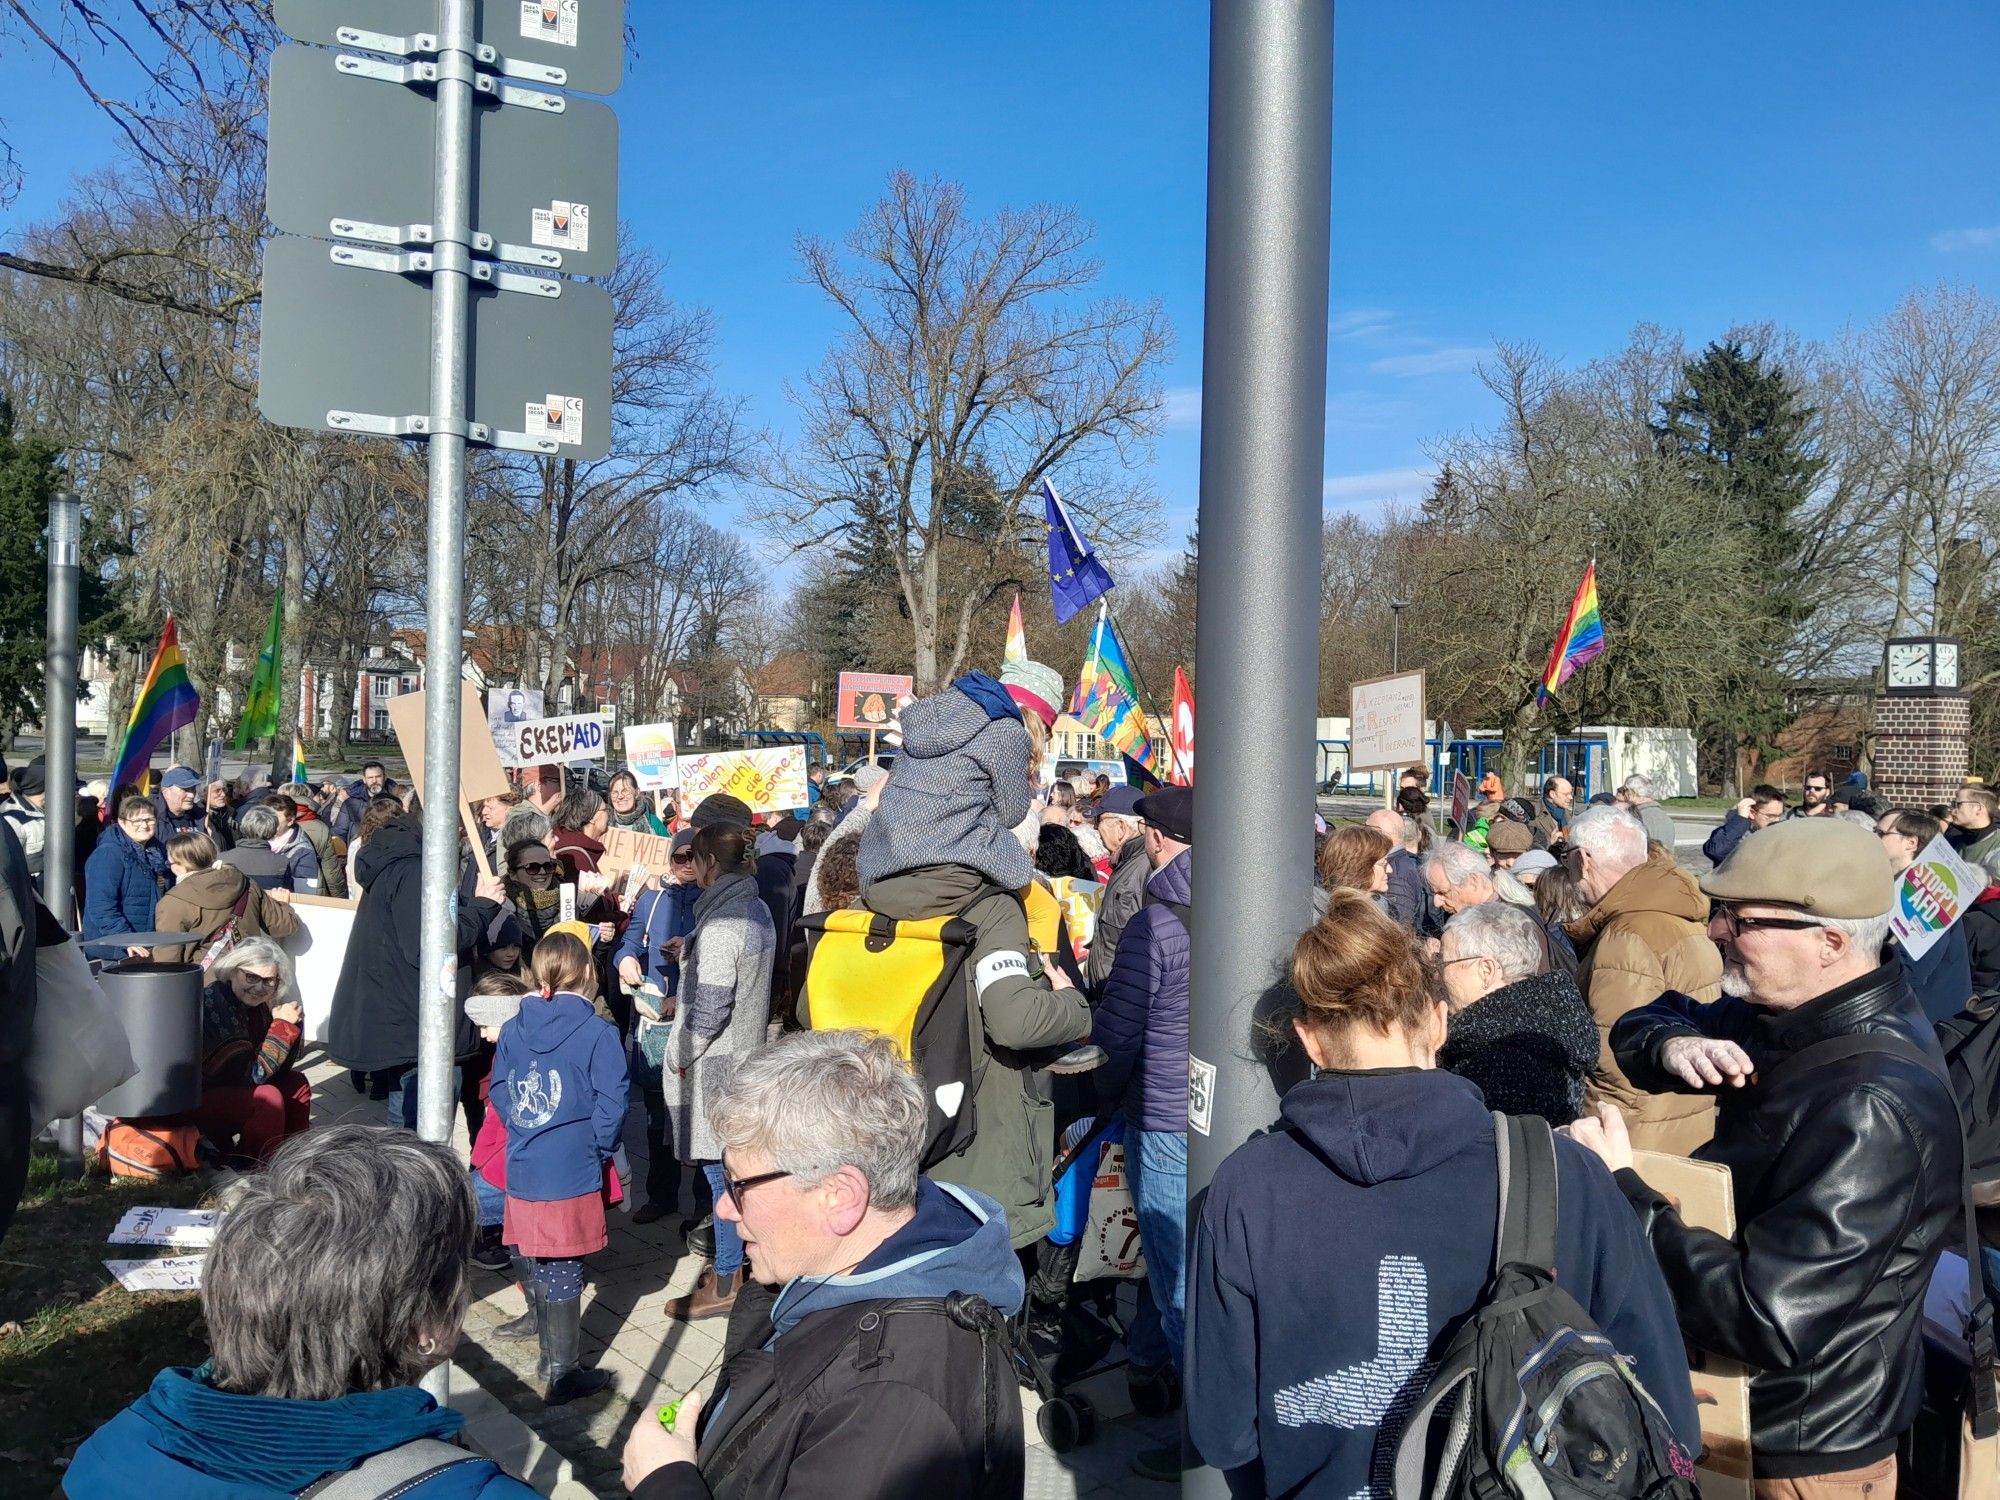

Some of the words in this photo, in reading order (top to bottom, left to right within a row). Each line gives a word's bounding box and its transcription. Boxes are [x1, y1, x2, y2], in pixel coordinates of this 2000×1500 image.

[678, 754, 710, 778] Über
[698, 764, 725, 790] allen
[746, 772, 762, 792] die
[754, 758, 790, 805] Sonne
[1908, 886, 1940, 923] AFD
[1604, 1447, 1628, 1480] euter
